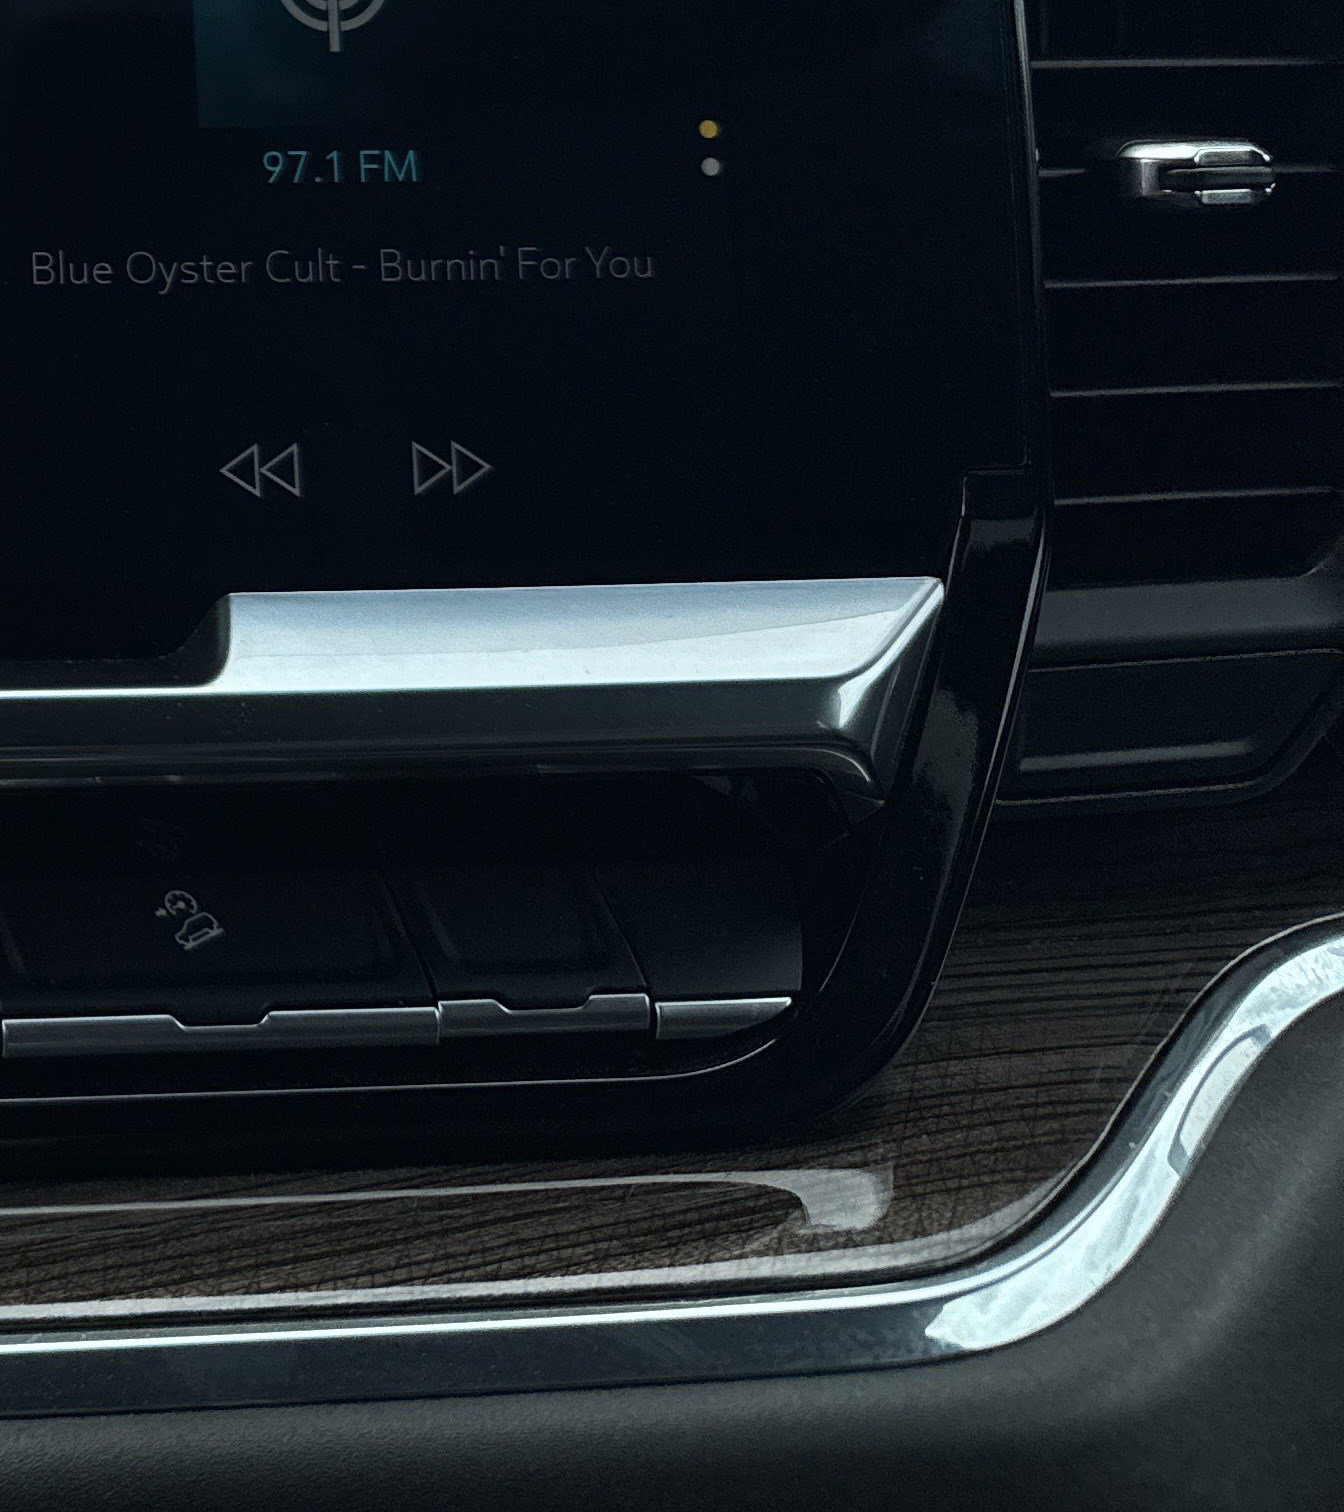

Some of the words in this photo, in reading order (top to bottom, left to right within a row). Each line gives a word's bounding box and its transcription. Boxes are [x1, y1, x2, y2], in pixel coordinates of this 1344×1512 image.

[261, 150, 342, 184] 97.1
[359, 149, 419, 183] FM
[31, 249, 114, 285] Blue
[125, 250, 254, 296] Oyster
[265, 247, 341, 284] Cult
[379, 245, 506, 283] Burnin'
[517, 245, 577, 281] For
[584, 245, 654, 280] You
